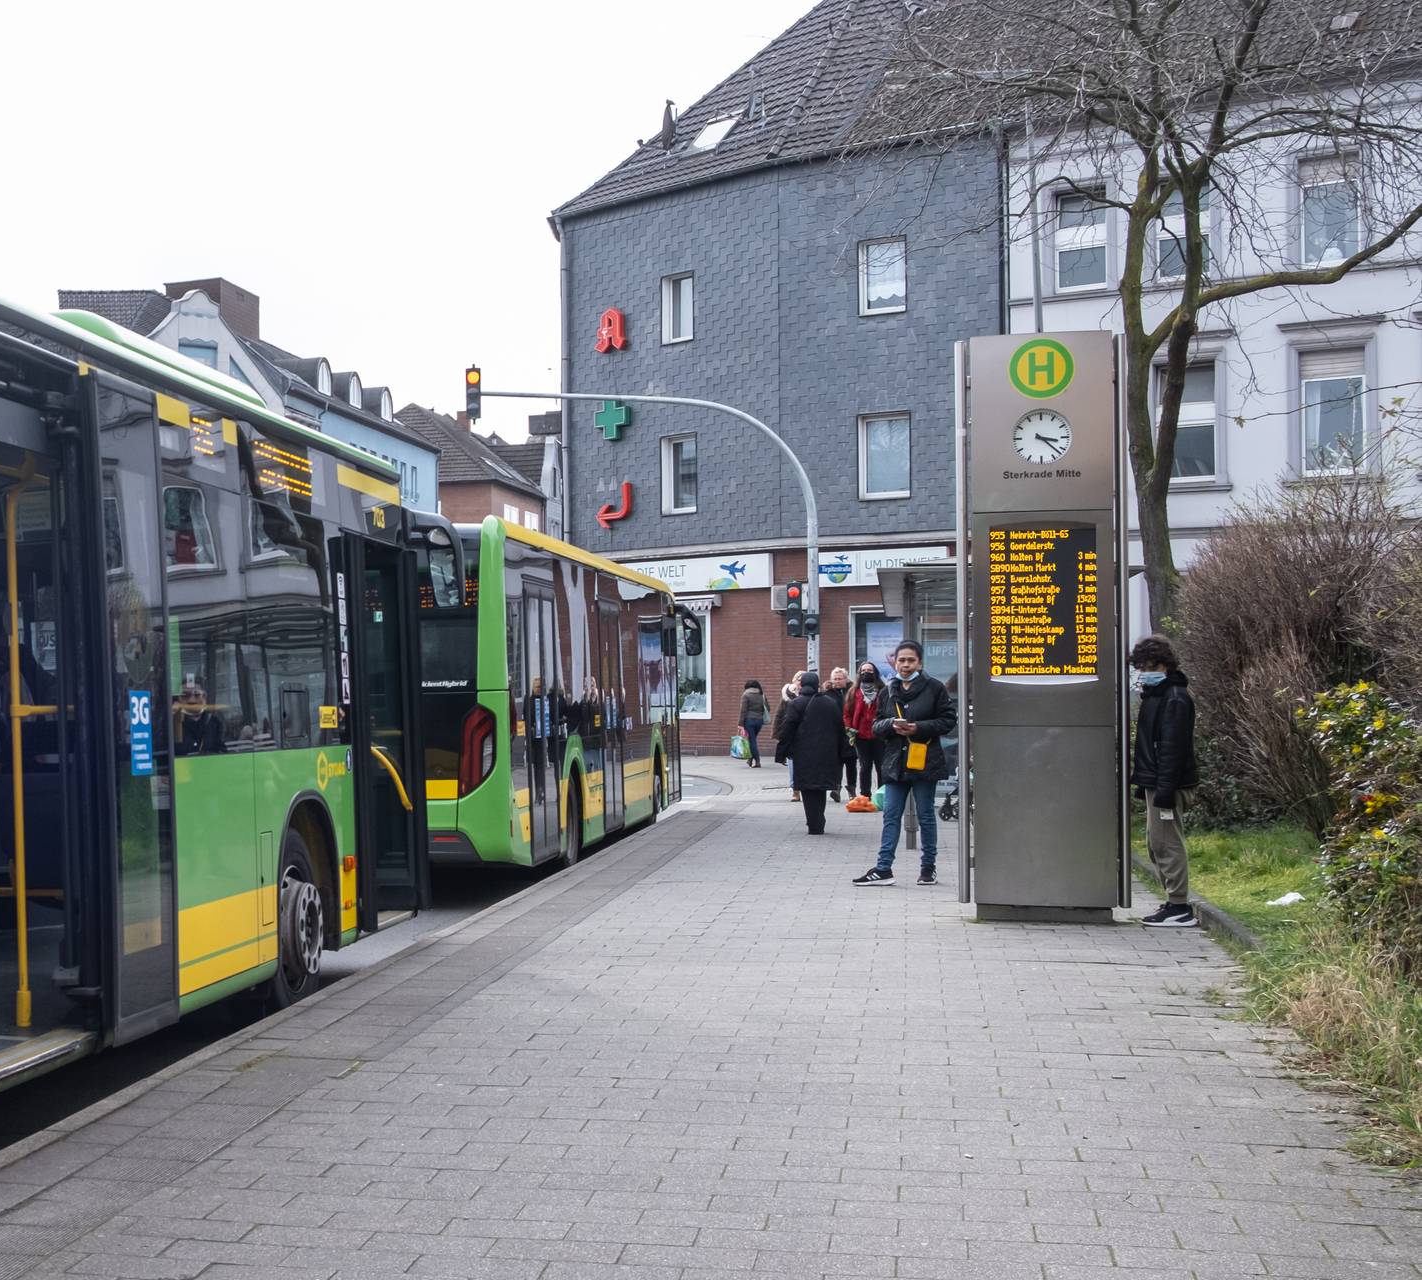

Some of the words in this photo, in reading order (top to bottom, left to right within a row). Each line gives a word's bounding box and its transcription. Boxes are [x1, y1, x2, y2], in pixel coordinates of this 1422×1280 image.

[1028, 351, 1055, 385] H
[1003, 471, 1053, 480] Sterkrade
[1056, 470, 1082, 478] Mitte
[990, 531, 1006, 540] 955
[990, 542, 1006, 550] 956
[990, 553, 1006, 562] 960
[1036, 552, 1044, 562] Bf
[1078, 552, 1083, 560] 3
[1085, 551, 1096, 560] min
[658, 565, 686, 578] WELT
[990, 564, 1010, 572] SB90
[1036, 563, 1056, 572] Markt
[1085, 562, 1096, 570] min
[990, 575, 1006, 584] 952
[1078, 574, 1083, 582] 4
[1085, 574, 1096, 582] min
[990, 586, 1006, 594] 957
[1078, 585, 1084, 593] 5
[1085, 584, 1096, 592] min
[991, 596, 1006, 604] 979
[1011, 596, 1044, 604] Sterkrade
[1046, 595, 1055, 605] Bf
[991, 606, 1010, 614] SB94
[1076, 605, 1083, 613] 11
[1086, 604, 1097, 613] min
[1076, 615, 1084, 623] 15
[1086, 614, 1097, 622] min
[991, 626, 1006, 634] 976
[1076, 625, 1084, 634] 15
[1086, 625, 1097, 633] min
[991, 636, 1006, 644] 263
[1047, 636, 1056, 646] Bf
[1078, 635, 1096, 643] 15:39
[991, 646, 1006, 654] 962
[1011, 646, 1044, 656] Kleekamp
[1078, 645, 1096, 654] 15:55
[1078, 655, 1096, 664] 16:09
[1005, 666, 1060, 674] medizinische
[1064, 665, 1096, 674] Masken
[131, 696, 150, 725] 3G
